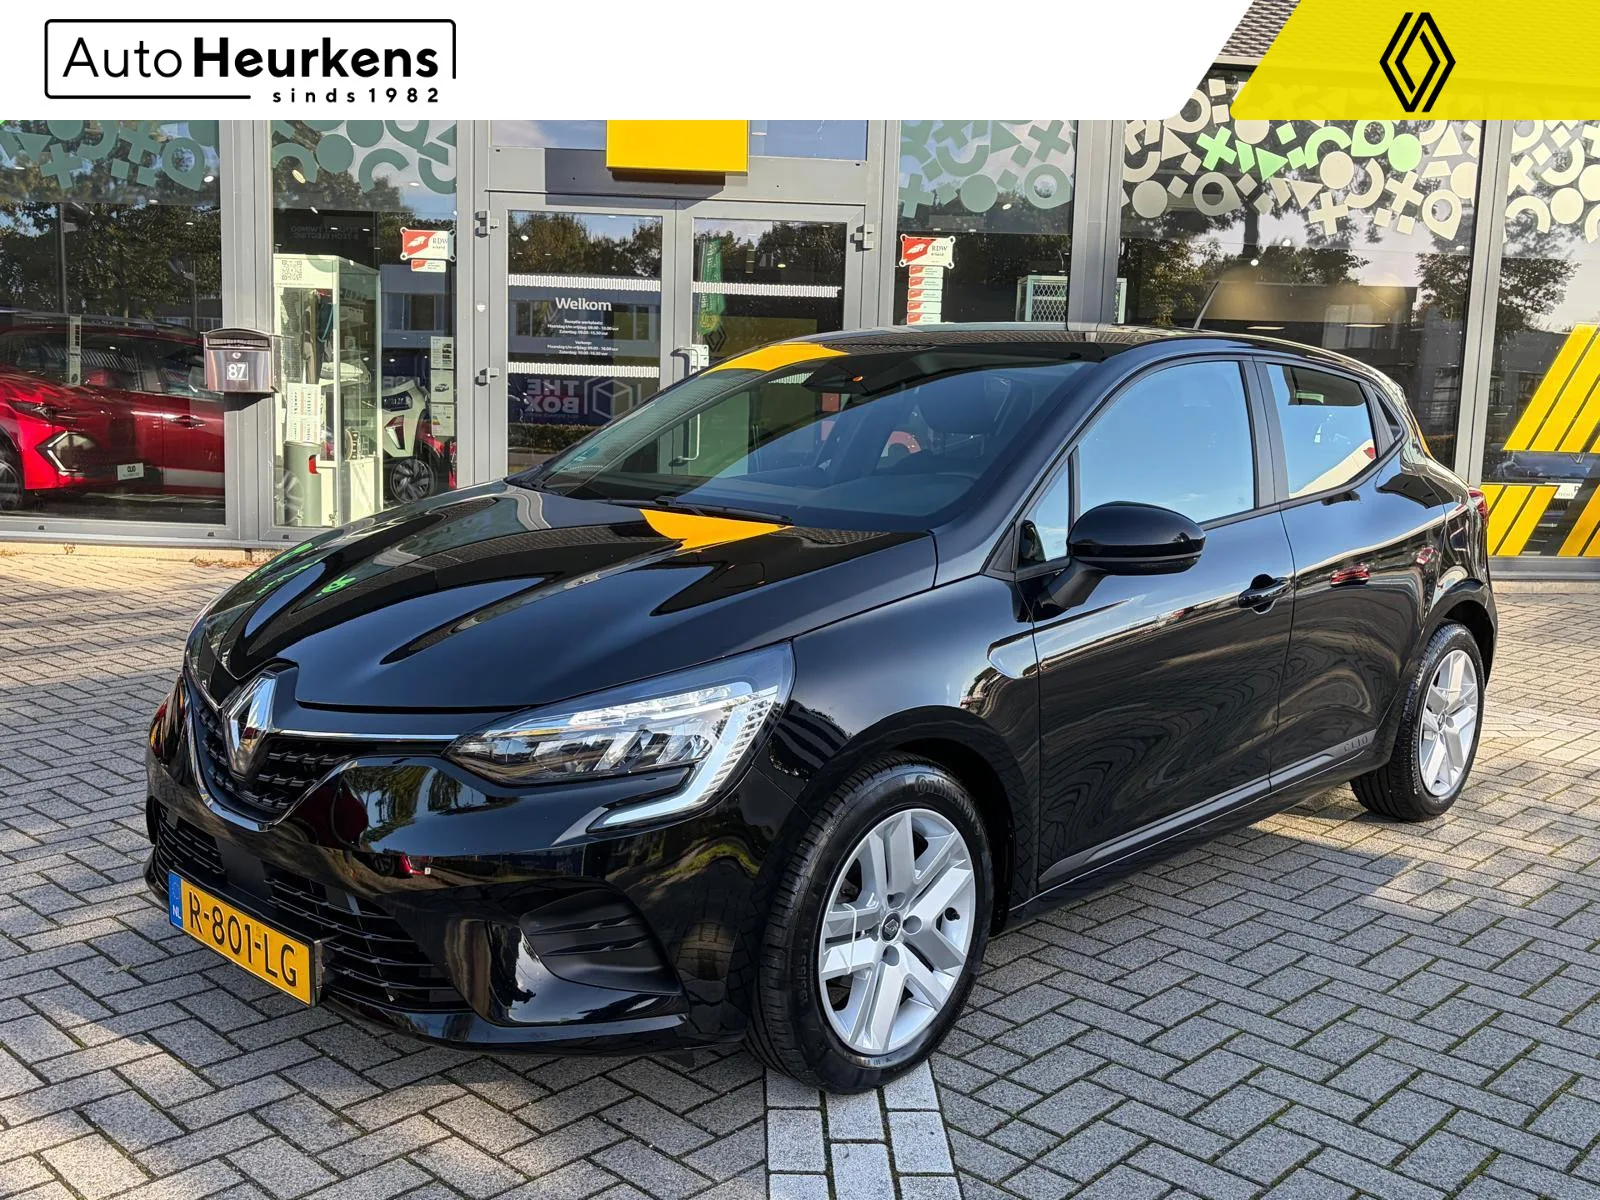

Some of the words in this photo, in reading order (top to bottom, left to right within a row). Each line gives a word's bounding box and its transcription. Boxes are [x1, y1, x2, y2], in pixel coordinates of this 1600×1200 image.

[555, 296, 612, 312] Welkom
[228, 363, 246, 378] 87
[1343, 735, 1368, 752] CLIO
[172, 904, 182, 920] NL
[188, 889, 297, 987] R-801-LG
